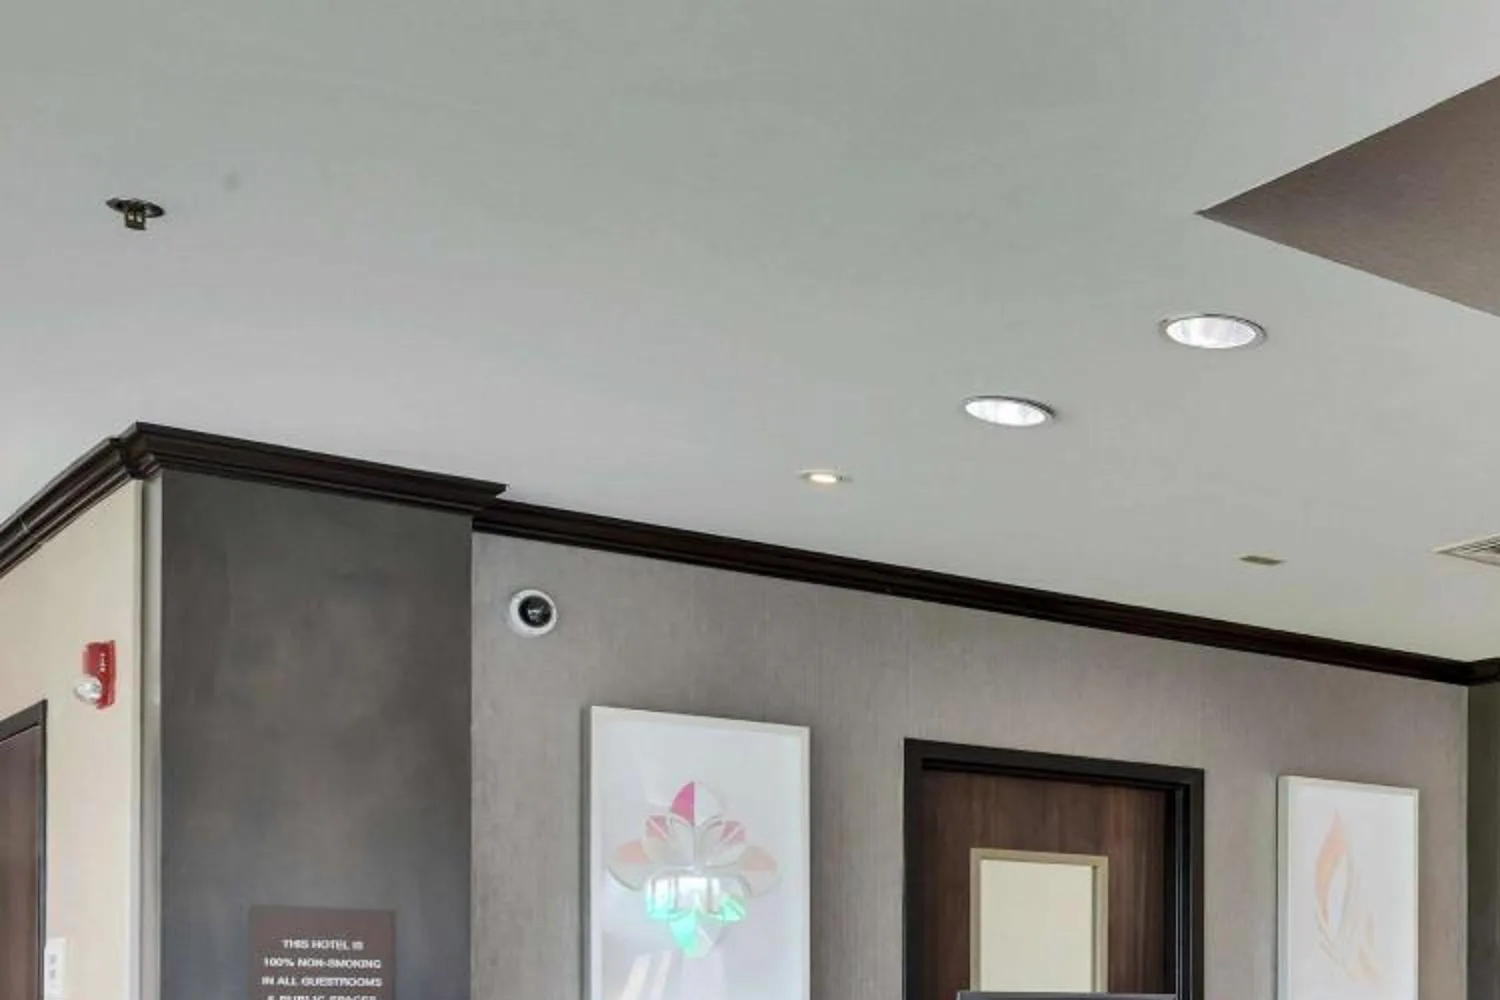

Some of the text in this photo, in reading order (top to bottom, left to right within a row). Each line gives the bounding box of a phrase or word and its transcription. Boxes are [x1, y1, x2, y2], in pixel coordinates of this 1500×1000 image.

[282, 939, 364, 951] THIS HOTEL IS
[263, 956, 382, 969] 100% NON-SMOKING
[261, 976, 382, 987] IN ALL GUESTROOMS
